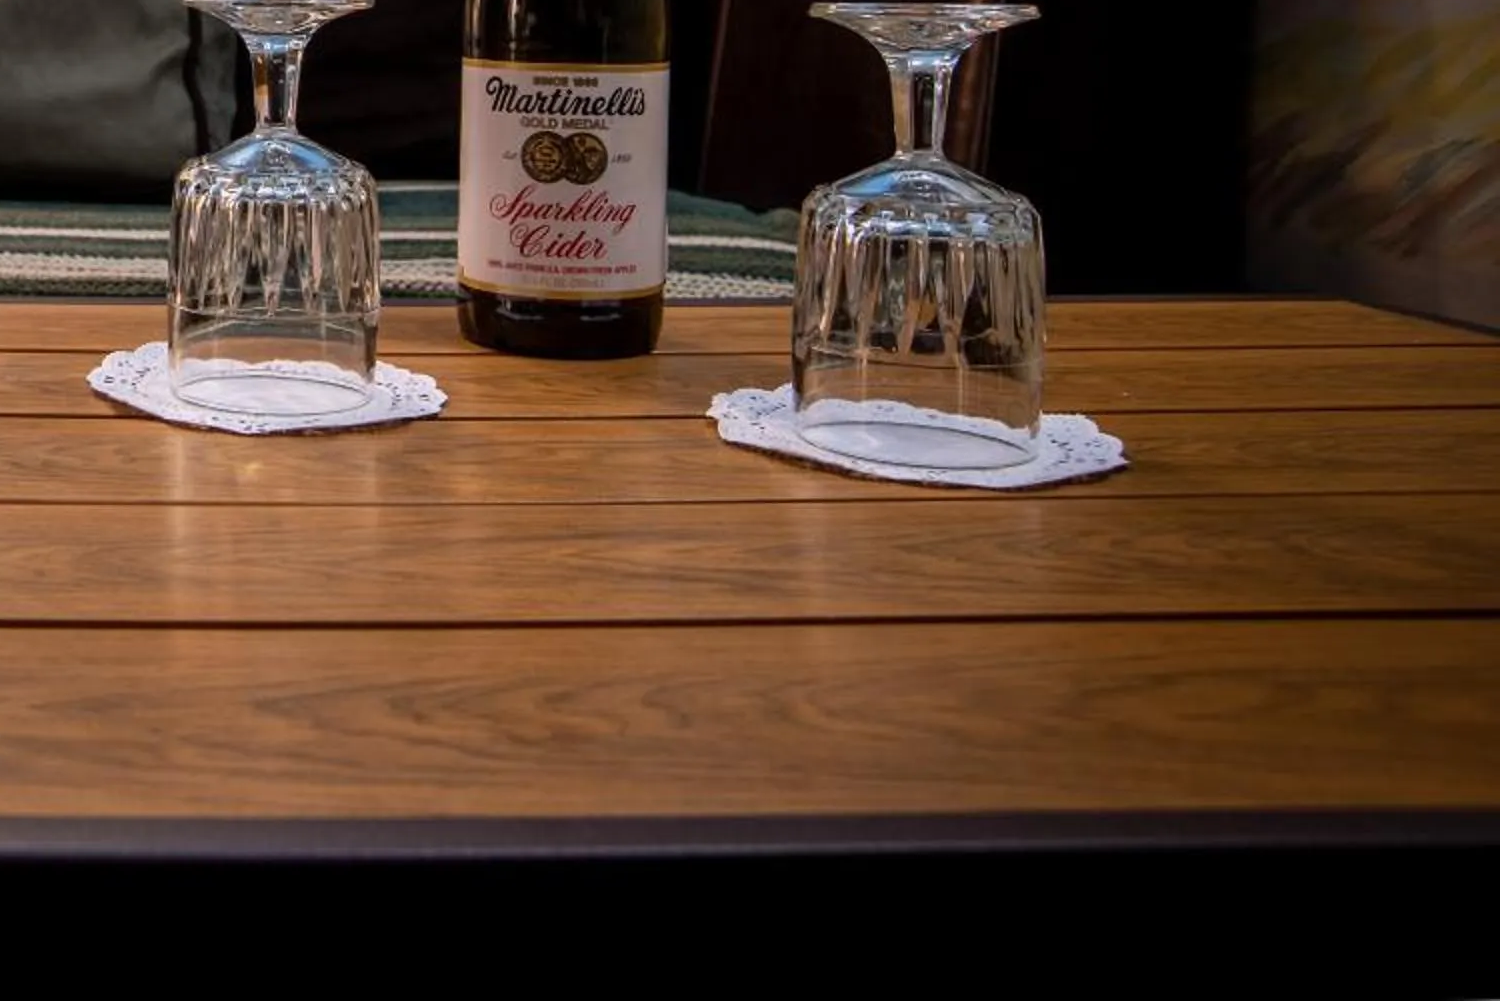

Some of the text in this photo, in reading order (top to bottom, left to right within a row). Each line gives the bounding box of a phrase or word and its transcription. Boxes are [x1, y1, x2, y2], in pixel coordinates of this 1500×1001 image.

[520, 116, 609, 130] GOLD MEDAL
[489, 184, 637, 235] Sparkling
[509, 223, 609, 260] Cider
